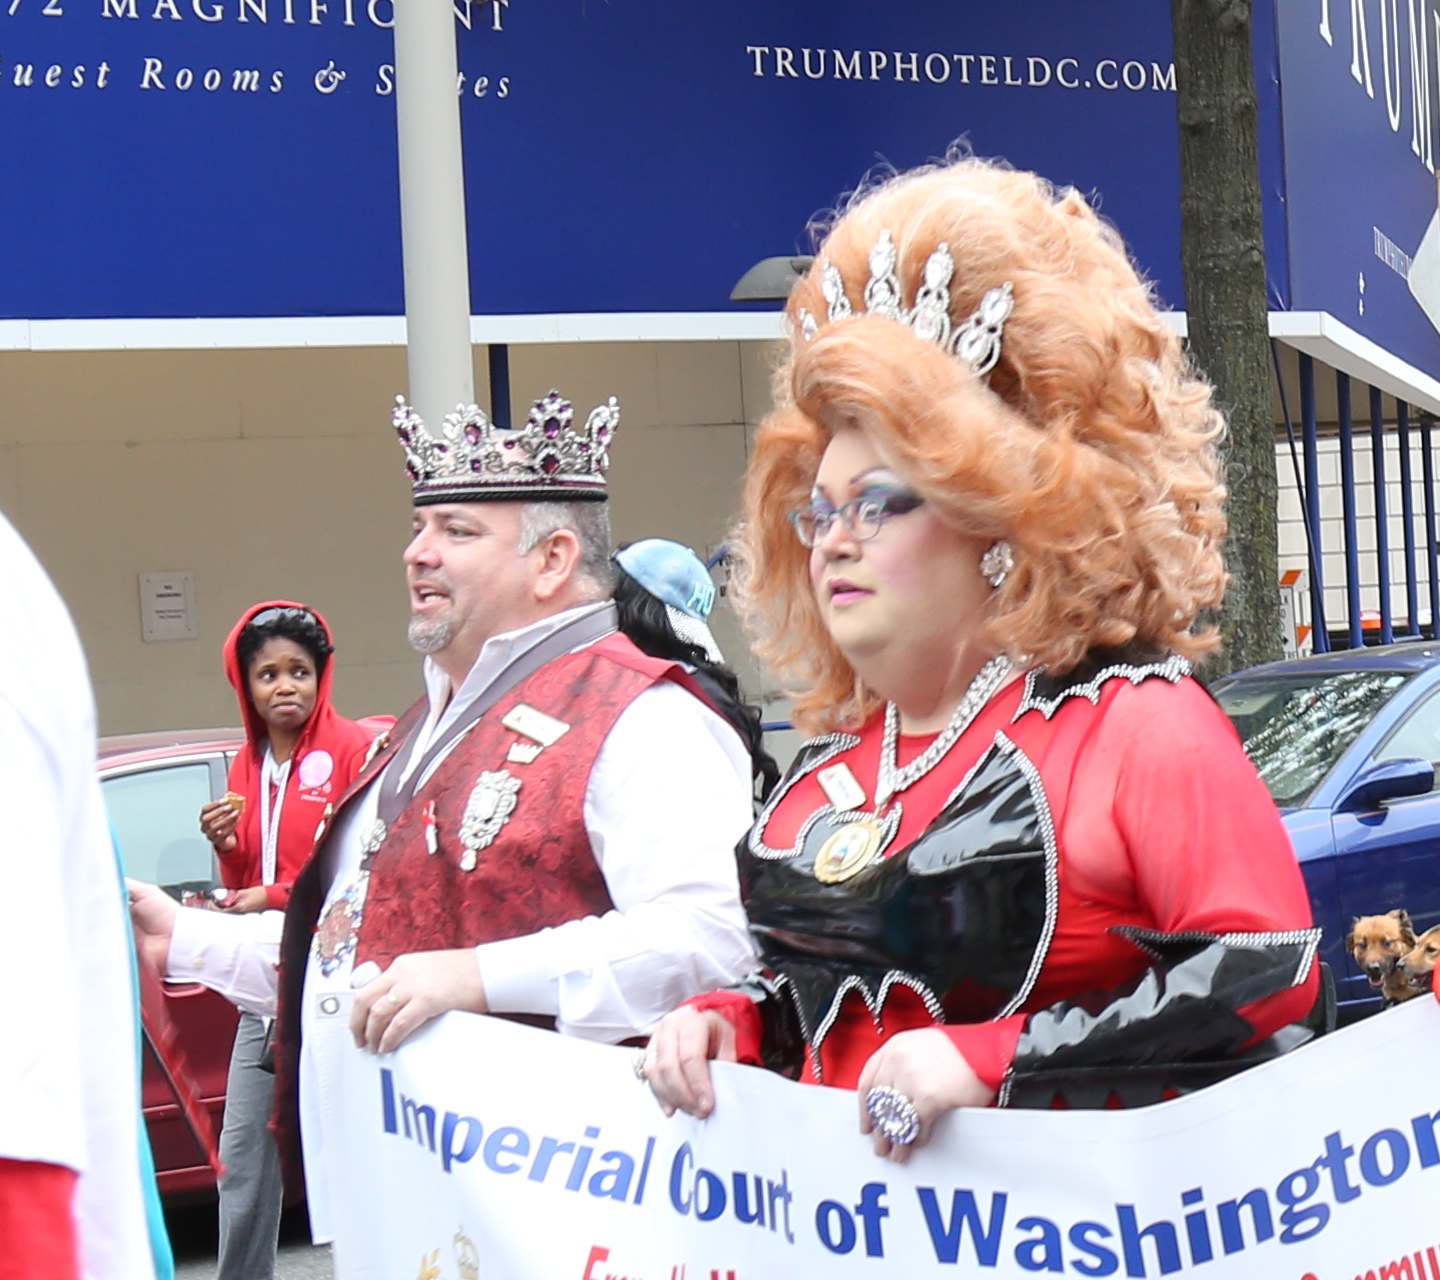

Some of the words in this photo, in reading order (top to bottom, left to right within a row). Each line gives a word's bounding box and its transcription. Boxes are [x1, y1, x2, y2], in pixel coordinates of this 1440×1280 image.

[140, 57, 284, 93] Rooms
[314, 61, 346, 94] &
[375, 64, 510, 98] Stes
[746, 45, 1177, 92] TRUMPHOTELDC.COM
[379, 1067, 656, 1207] Imperial
[669, 1140, 795, 1244] Court
[815, 1181, 890, 1258] of
